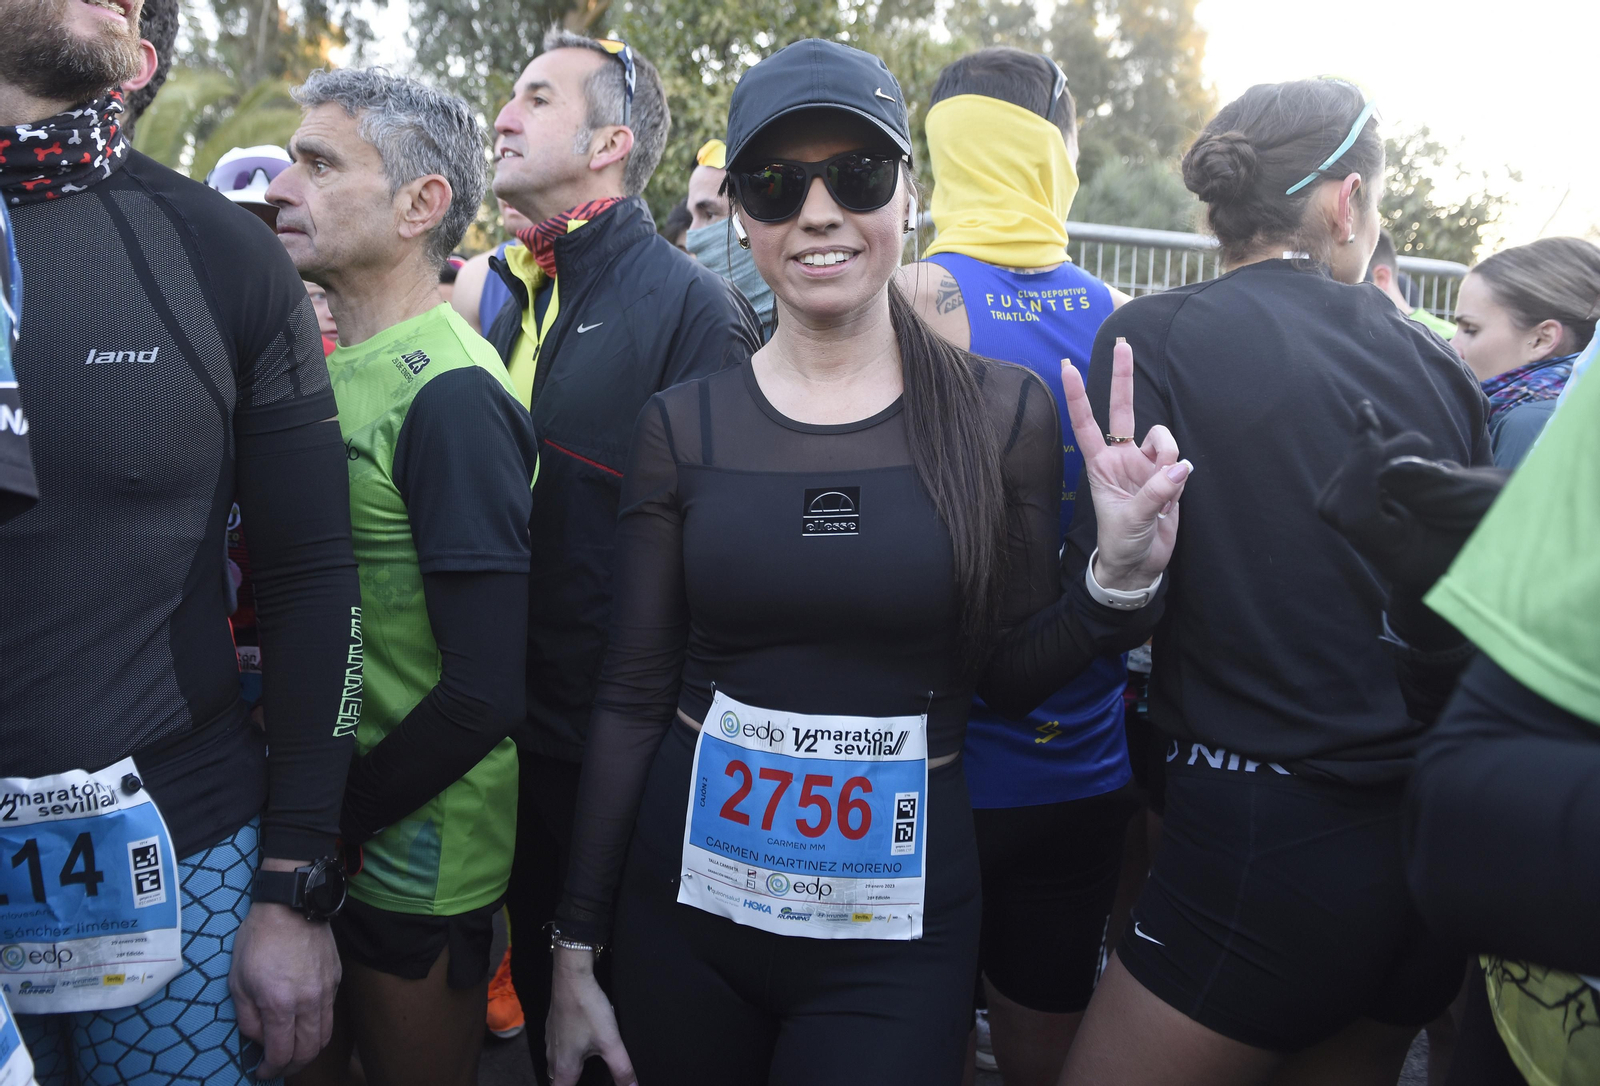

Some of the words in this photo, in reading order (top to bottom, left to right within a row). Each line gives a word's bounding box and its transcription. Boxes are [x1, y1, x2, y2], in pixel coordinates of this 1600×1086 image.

[986, 293, 1091, 313] FUENTES
[1018, 290, 1039, 298] CLUB
[1041, 287, 1087, 299] DEPORTIVO
[990, 310, 1040, 322] TRIATLÓN
[85, 346, 159, 365] land
[401, 349, 430, 375] 2023
[742, 721, 785, 747] edp
[815, 728, 893, 743] maratón
[834, 741, 893, 756] sevilla
[12, 781, 107, 807] maratón
[38, 793, 113, 817] sevilla
[719, 759, 873, 841] 2756
[706, 836, 759, 861] CARMEN
[764, 854, 837, 872] MARTINEZ
[842, 862, 902, 873] MORENO
[767, 838, 807, 850] CARMEN
[0, 831, 104, 905] 14
[793, 877, 832, 900] edp
[743, 899, 772, 914] HOKA
[4, 924, 71, 940] Sánchez
[77, 918, 139, 934] Jiménez
[29, 944, 73, 969] edp
